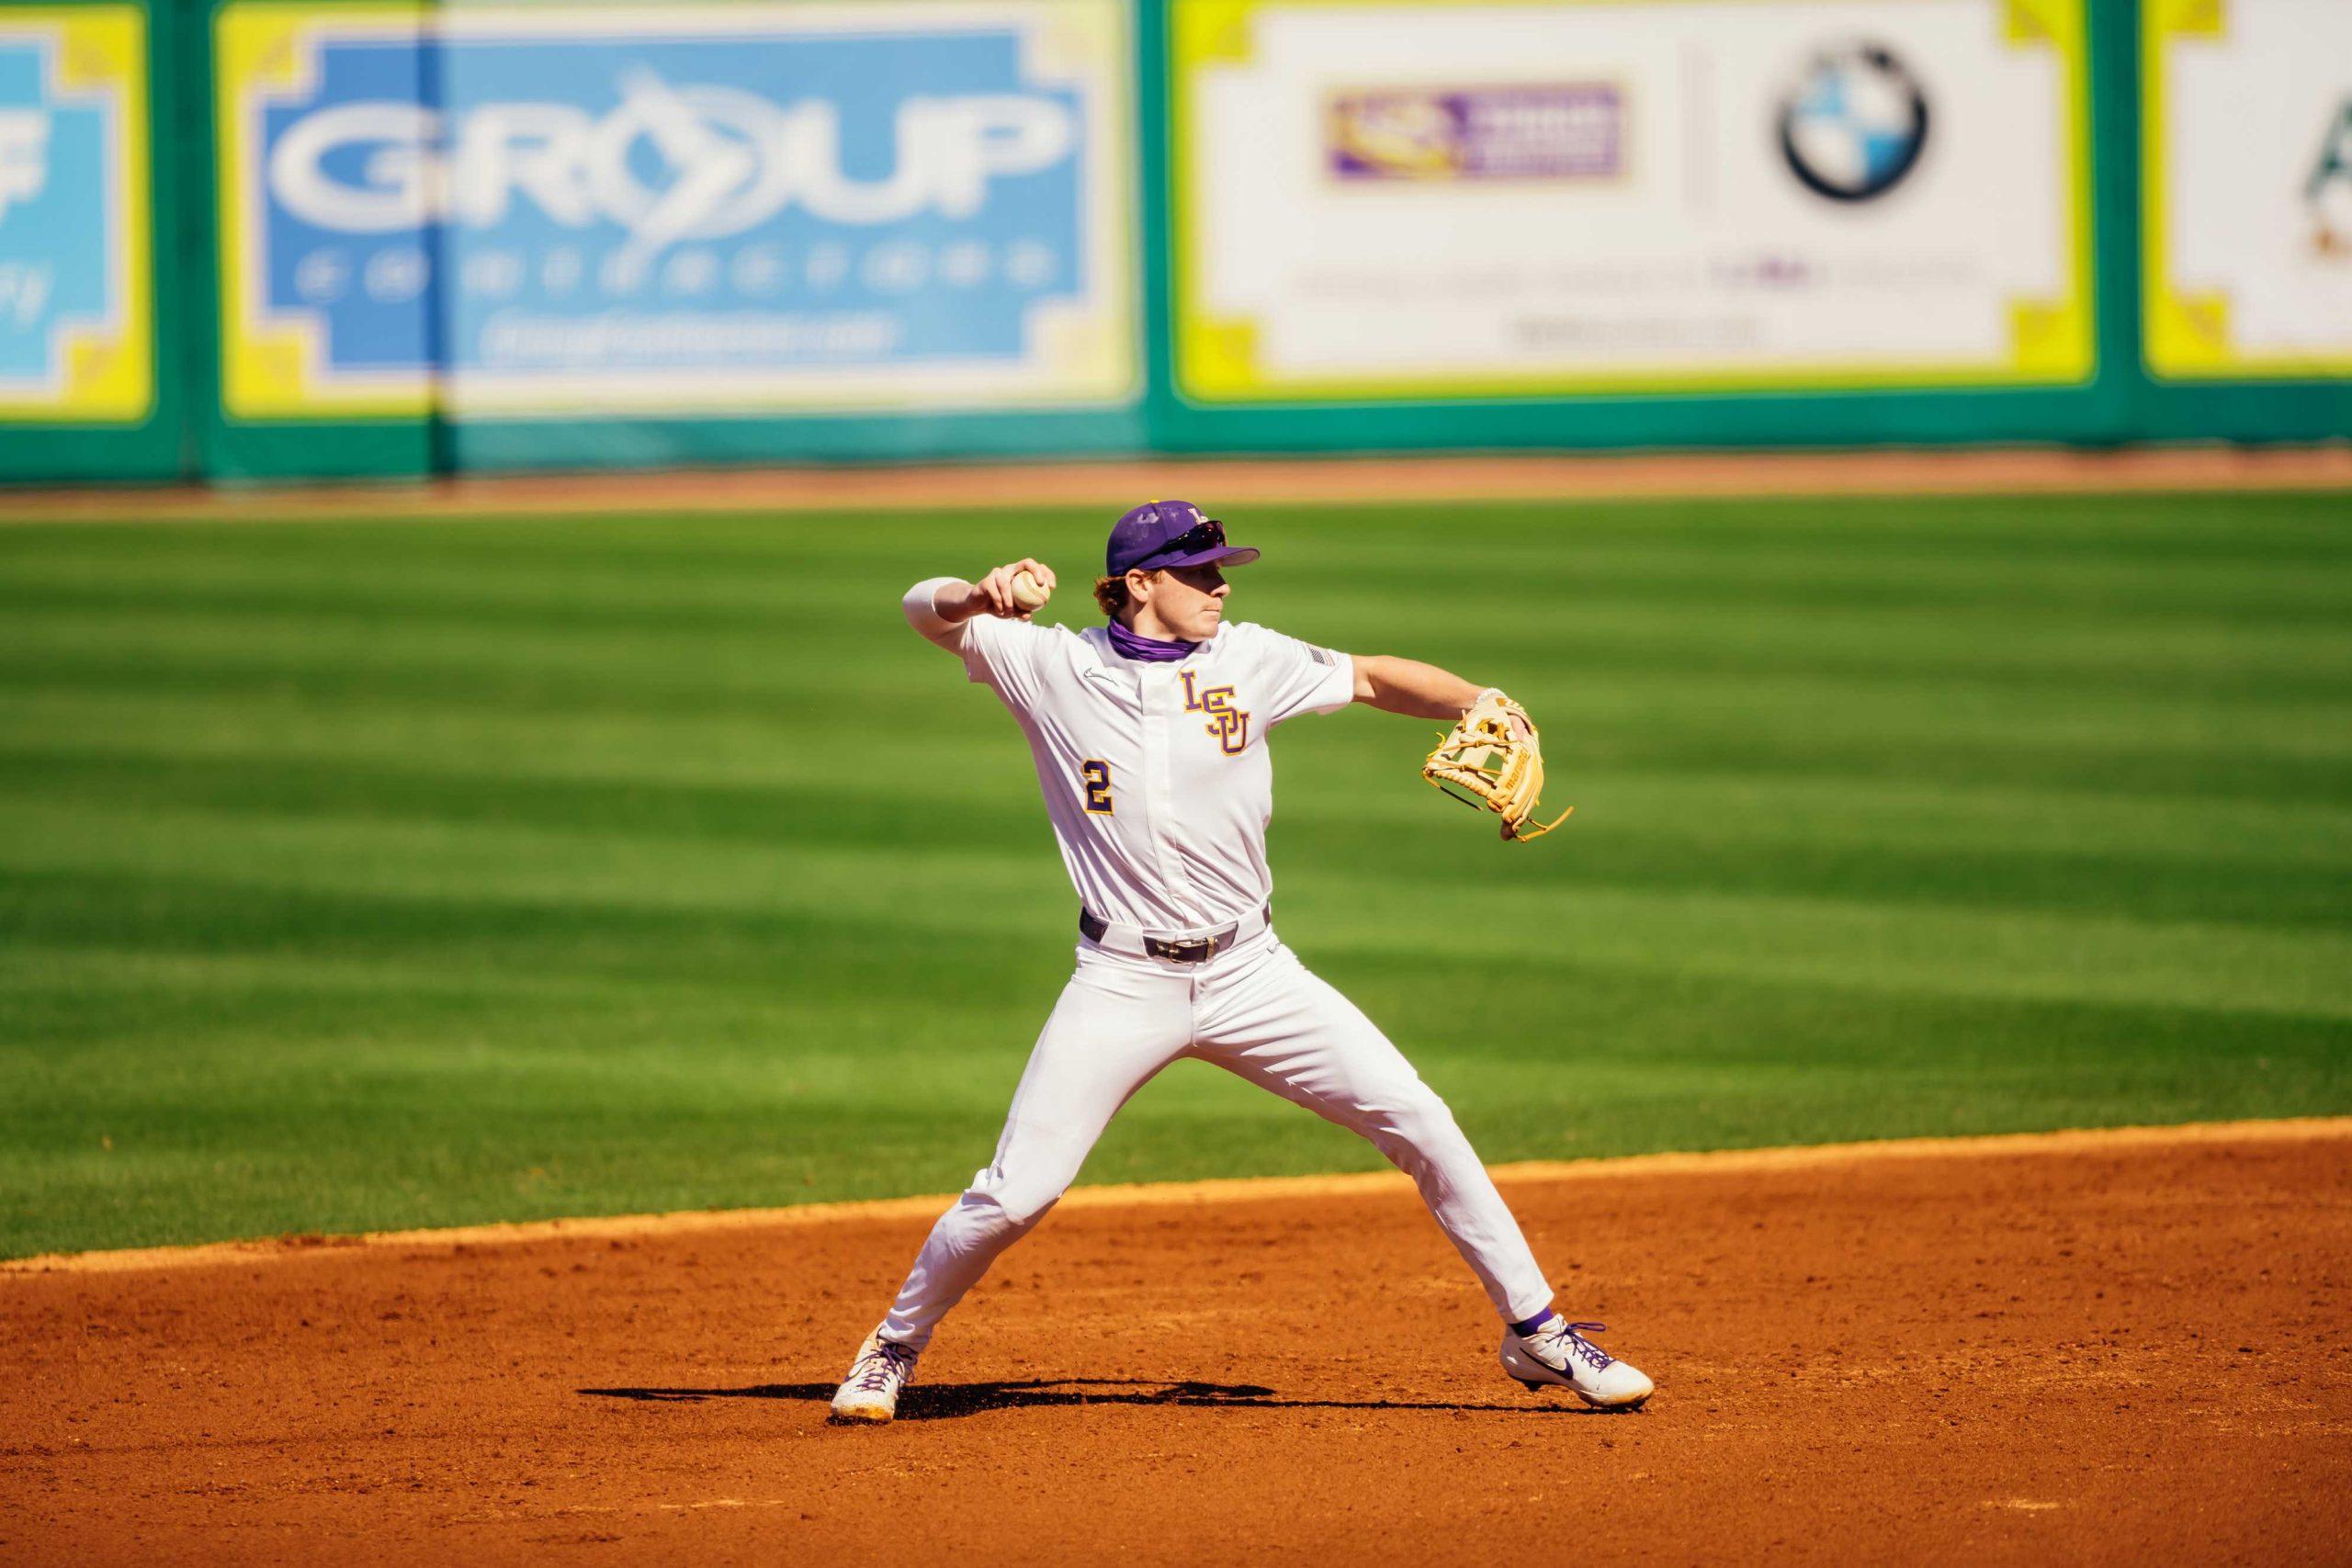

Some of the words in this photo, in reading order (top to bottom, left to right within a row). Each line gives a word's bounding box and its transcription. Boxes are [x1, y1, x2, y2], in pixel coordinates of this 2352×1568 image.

[268, 85, 1077, 239] GROUP
[1180, 670, 1250, 757] LSU
[1081, 758, 1114, 817] 2
